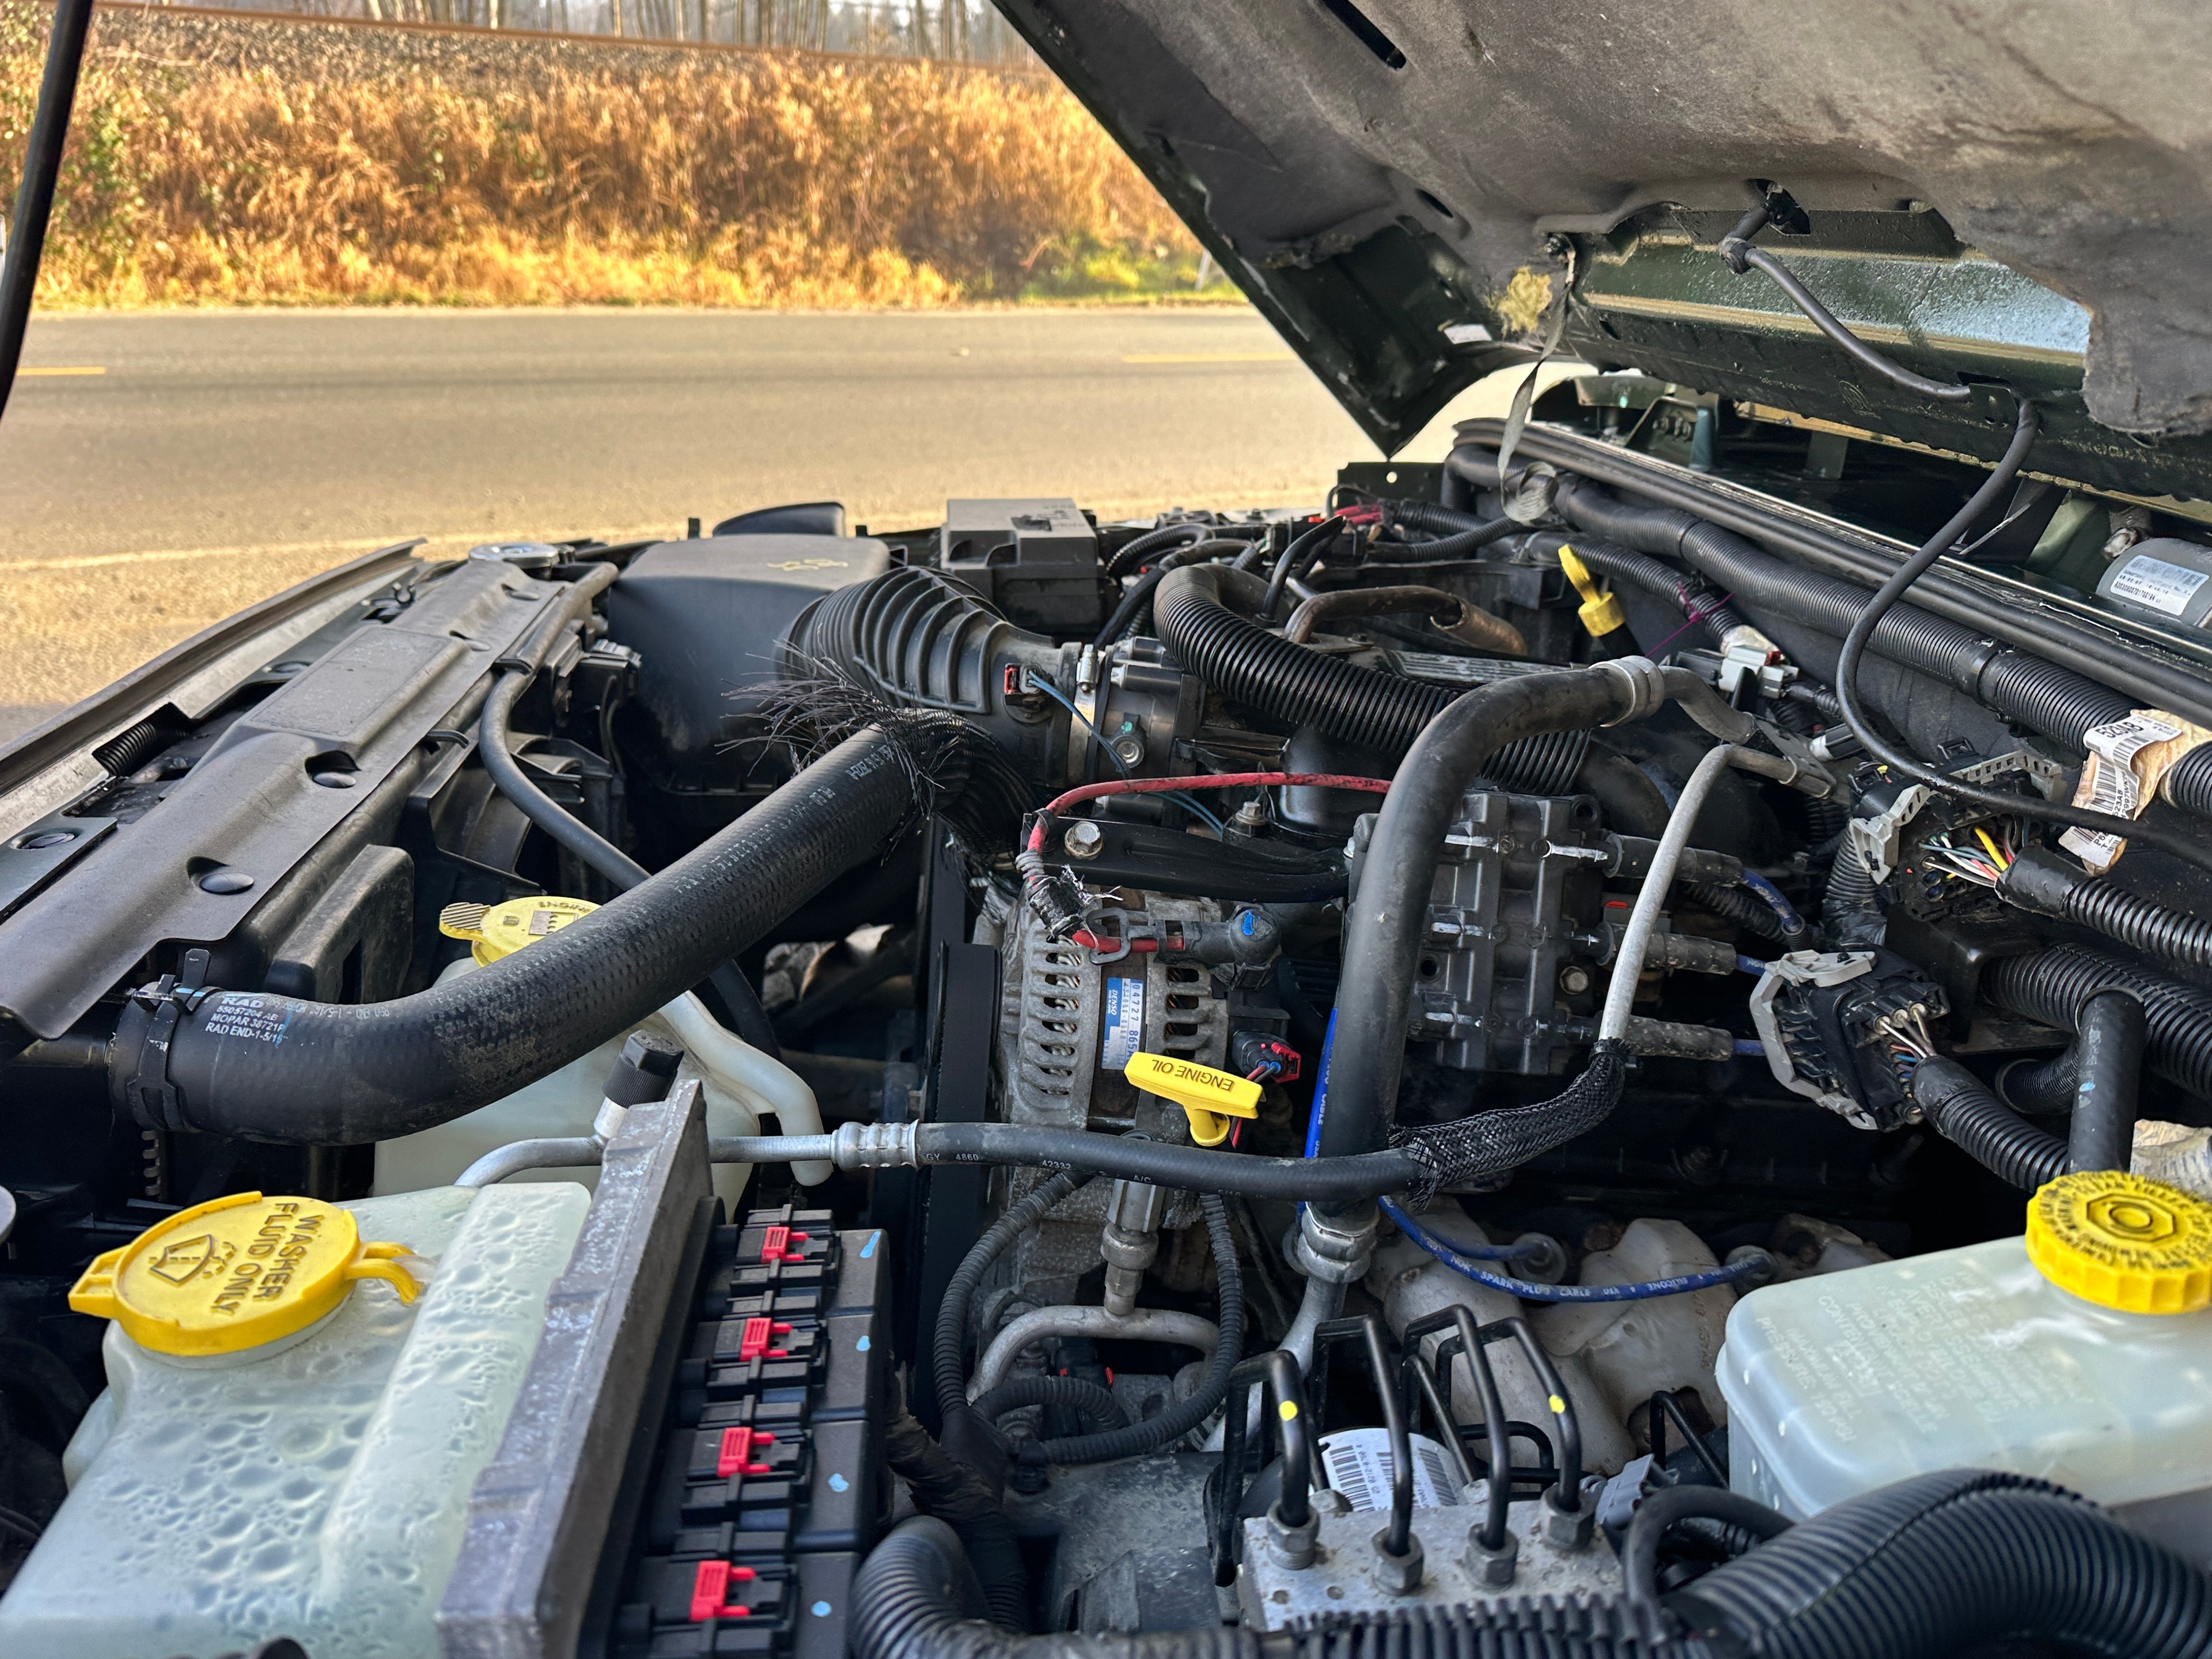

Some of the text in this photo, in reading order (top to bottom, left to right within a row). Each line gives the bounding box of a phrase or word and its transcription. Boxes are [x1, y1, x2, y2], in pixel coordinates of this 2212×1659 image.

[217, 1005, 279, 1021] 55057204 AB
[1131, 984, 1141, 1022] 04727
[205, 1022, 229, 1035] RAD
[210, 1013, 250, 1026] MOPAR
[1152, 1059, 1236, 1093] ENGINE OIL
[926, 1153, 941, 1162] GY
[956, 1153, 979, 1161] 4860
[1042, 1160, 1071, 1170] 42332
[1133, 1175, 1152, 1184] A/C
[210, 1202, 300, 1317] FLUID ONLY
[252, 1214, 325, 1302] WASHER
[1481, 1271, 1514, 1290] SPARK
[1522, 1283, 1551, 1296] PLUG
[1560, 1287, 1592, 1297] CABLE
[1603, 1287, 1620, 1296] USA
[1648, 1276, 1689, 1291] SILICONE
